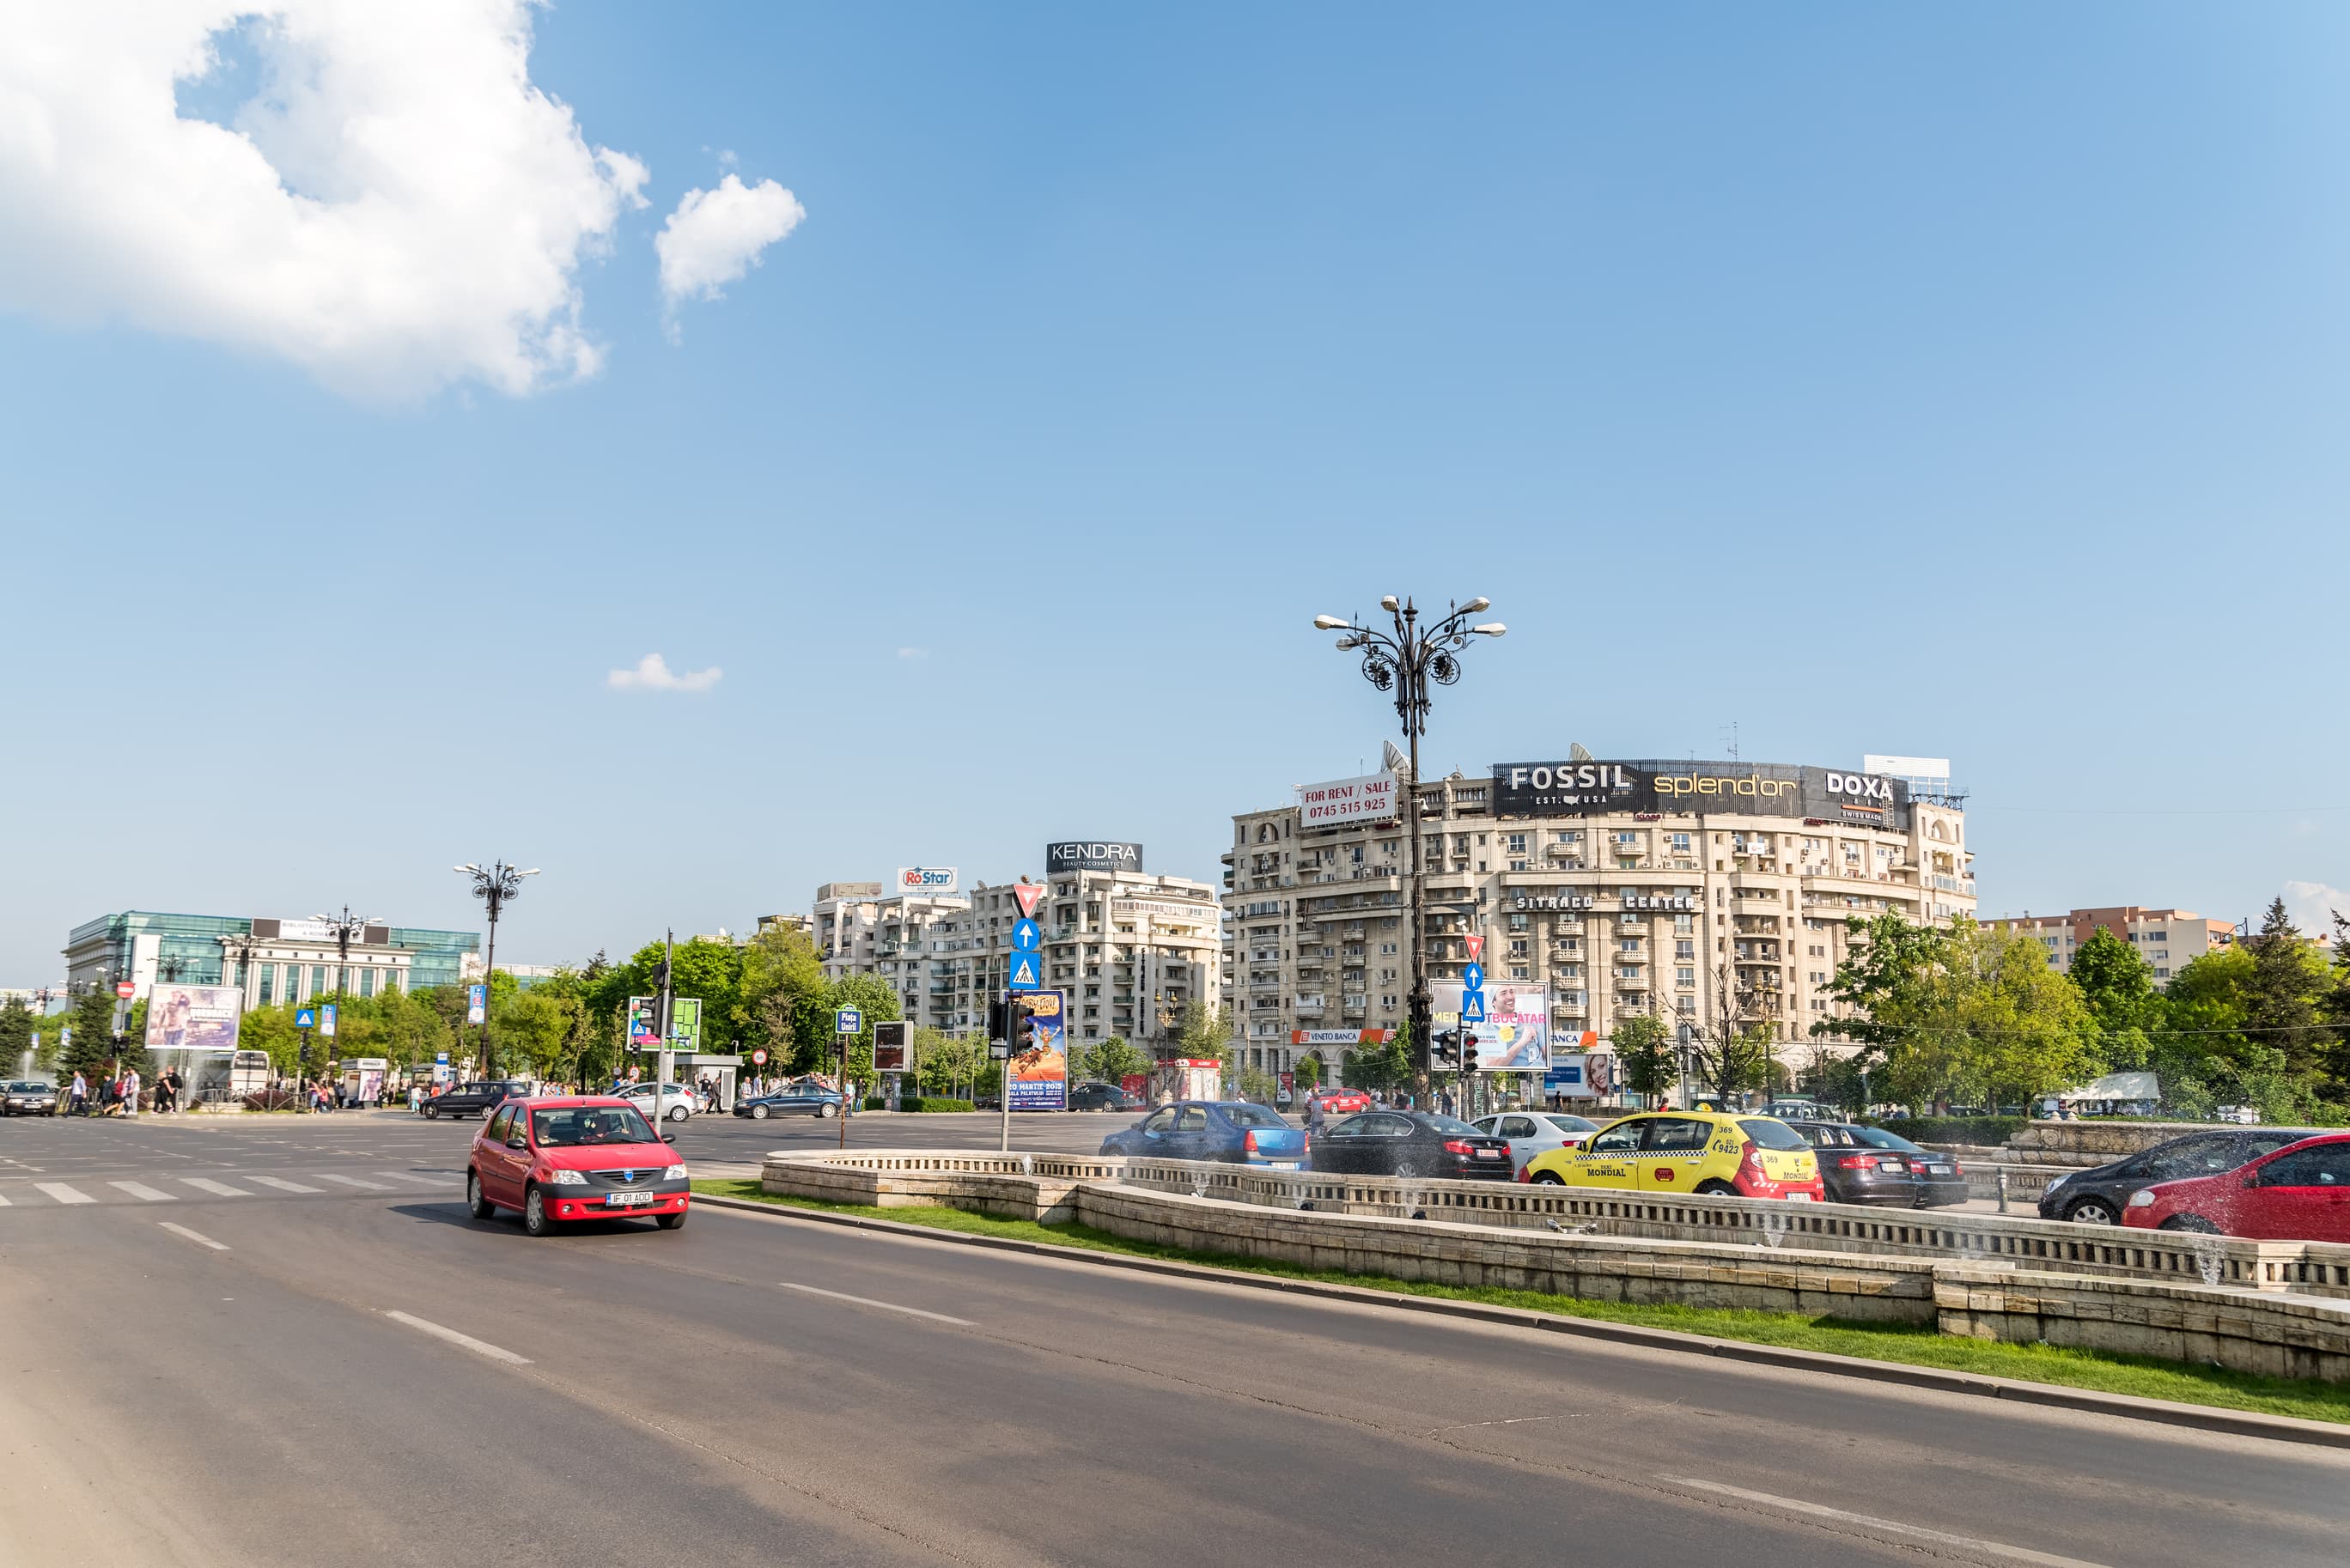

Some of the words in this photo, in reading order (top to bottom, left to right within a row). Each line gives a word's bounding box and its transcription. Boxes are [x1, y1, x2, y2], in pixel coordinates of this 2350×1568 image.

[1511, 765, 1630, 790] FOSSIL
[1653, 771, 1797, 799] splend'or
[1826, 773, 1894, 801] DOXA
[1305, 790, 1325, 803] FOR
[1328, 786, 1355, 799] RENT
[1356, 784, 1362, 799] /
[1365, 781, 1391, 794] SALE
[1309, 805, 1337, 818] 0745
[1339, 801, 1361, 815] 515
[1364, 798, 1386, 811] 925
[1865, 812, 1882, 821] MADE
[1052, 843, 1137, 860] KENDRA
[906, 872, 950, 884] RoStar
[1516, 896, 1593, 909] SITRACO
[1626, 896, 1695, 909] CENTER
[842, 1022, 856, 1031] Unirii
[1311, 1032, 1333, 1041] VENETO
[1335, 1032, 1357, 1041] BANCA
[1718, 1145, 1739, 1154] 9423
[1587, 1169, 1627, 1177] MONDIAL
[1783, 1171, 1809, 1180] MONDIAL
[613, 1194, 622, 1203] IF
